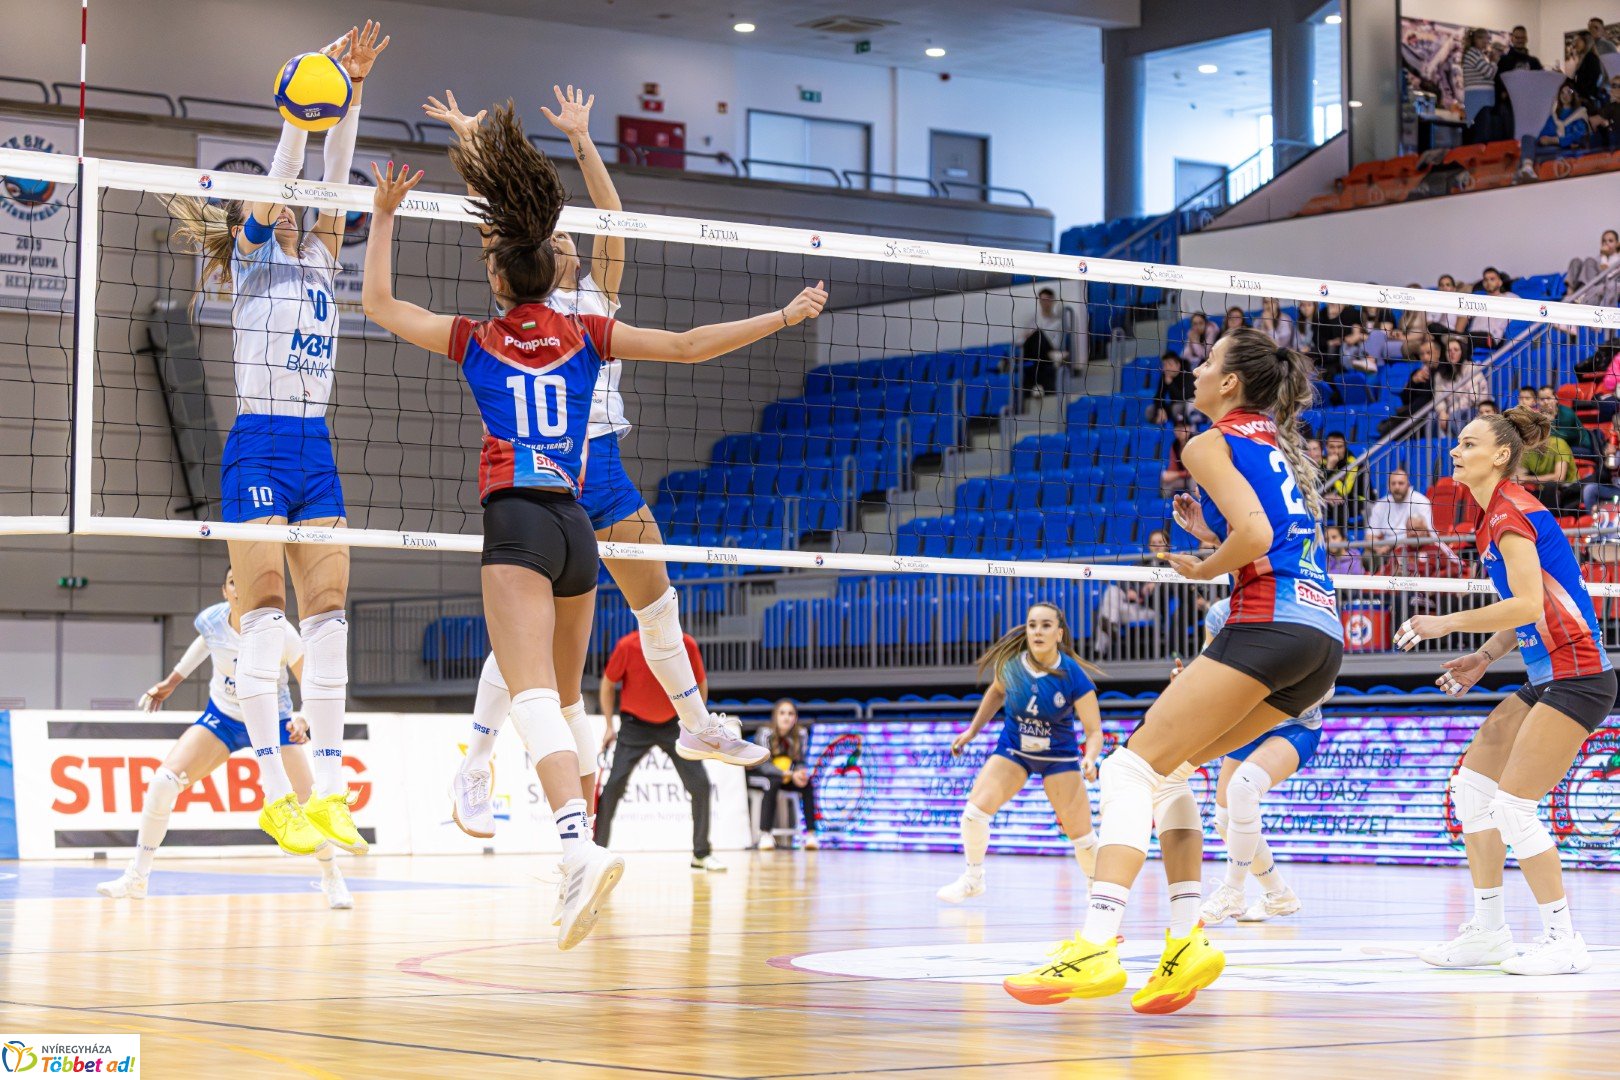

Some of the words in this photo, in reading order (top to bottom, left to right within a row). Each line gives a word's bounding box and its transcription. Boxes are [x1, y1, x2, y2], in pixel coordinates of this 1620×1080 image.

[699, 224, 739, 241] FATUM
[979, 252, 1015, 268] FATUM
[1229, 275, 1262, 290] FATUM
[1457, 297, 1488, 311] FATUM
[286, 353, 329, 379] BANK
[506, 374, 568, 438] 10
[248, 486, 274, 508] 10
[402, 534, 437, 547] FATUM
[706, 549, 738, 562] FATUM
[987, 563, 1016, 575] FATUM
[1026, 695, 1039, 716] 4
[203, 713, 222, 729] 12
[1019, 722, 1053, 736] BANK
[51, 756, 373, 815] STRABG
